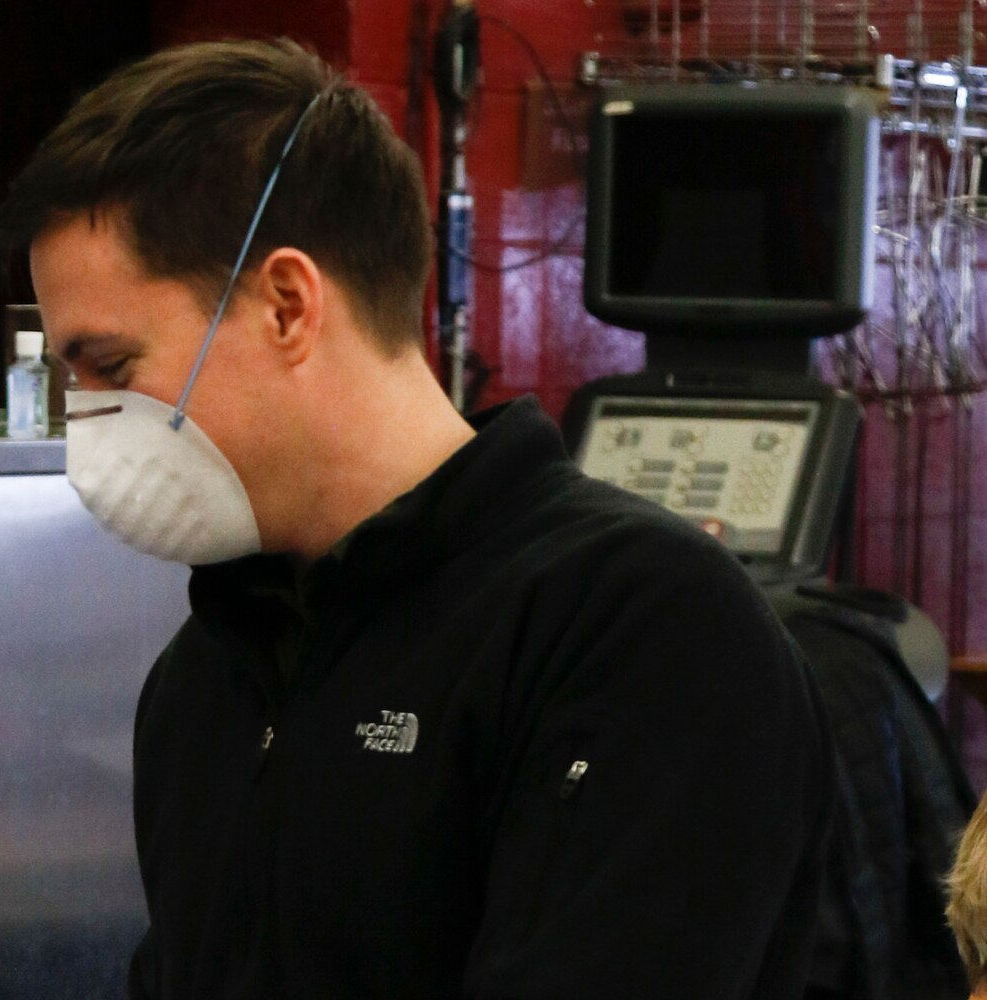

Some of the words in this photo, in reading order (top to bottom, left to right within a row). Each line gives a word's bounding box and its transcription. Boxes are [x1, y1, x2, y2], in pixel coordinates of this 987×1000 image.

[381, 710, 405, 724] THE
[356, 723, 399, 737] NORTH
[364, 738, 396, 751] FACE
